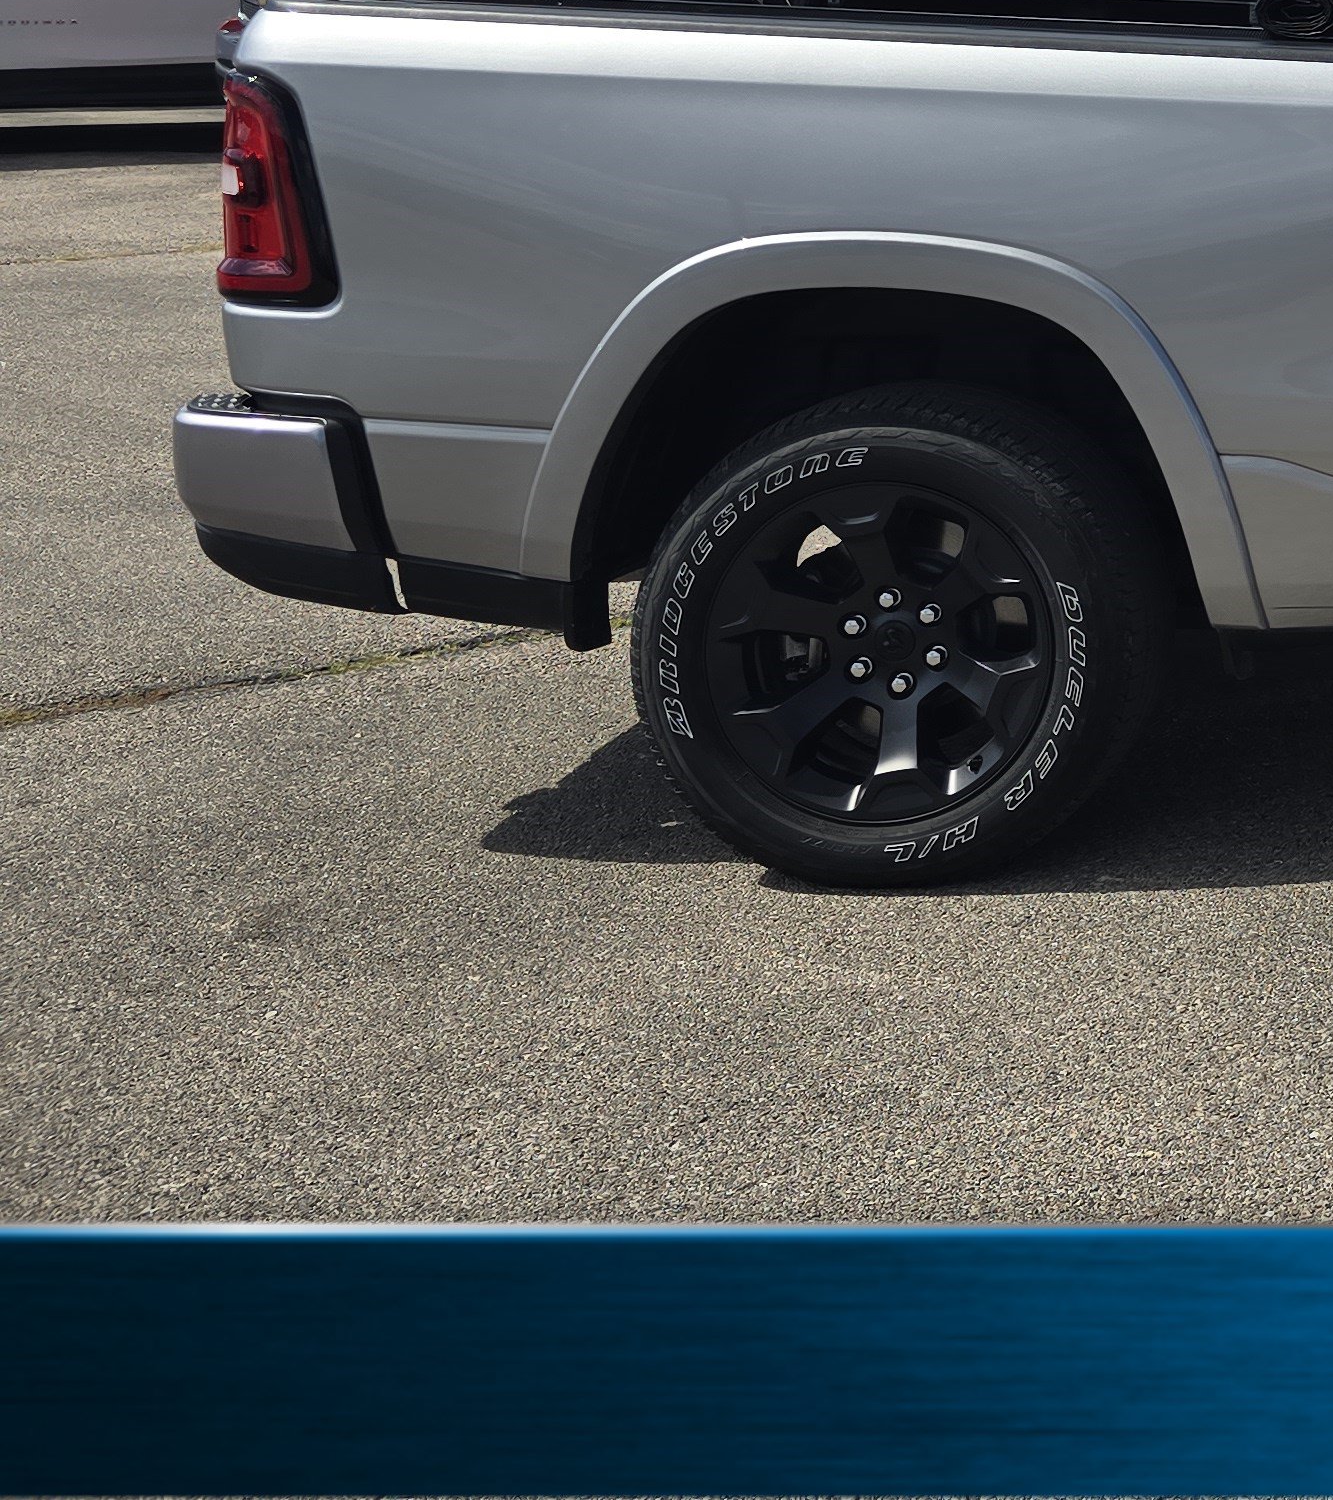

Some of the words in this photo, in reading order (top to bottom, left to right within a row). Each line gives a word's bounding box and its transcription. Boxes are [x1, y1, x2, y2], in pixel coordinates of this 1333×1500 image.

[658, 446, 869, 739] BRIDGESTONE
[1004, 580, 1086, 811] DUELER
[883, 815, 980, 863] H/L
